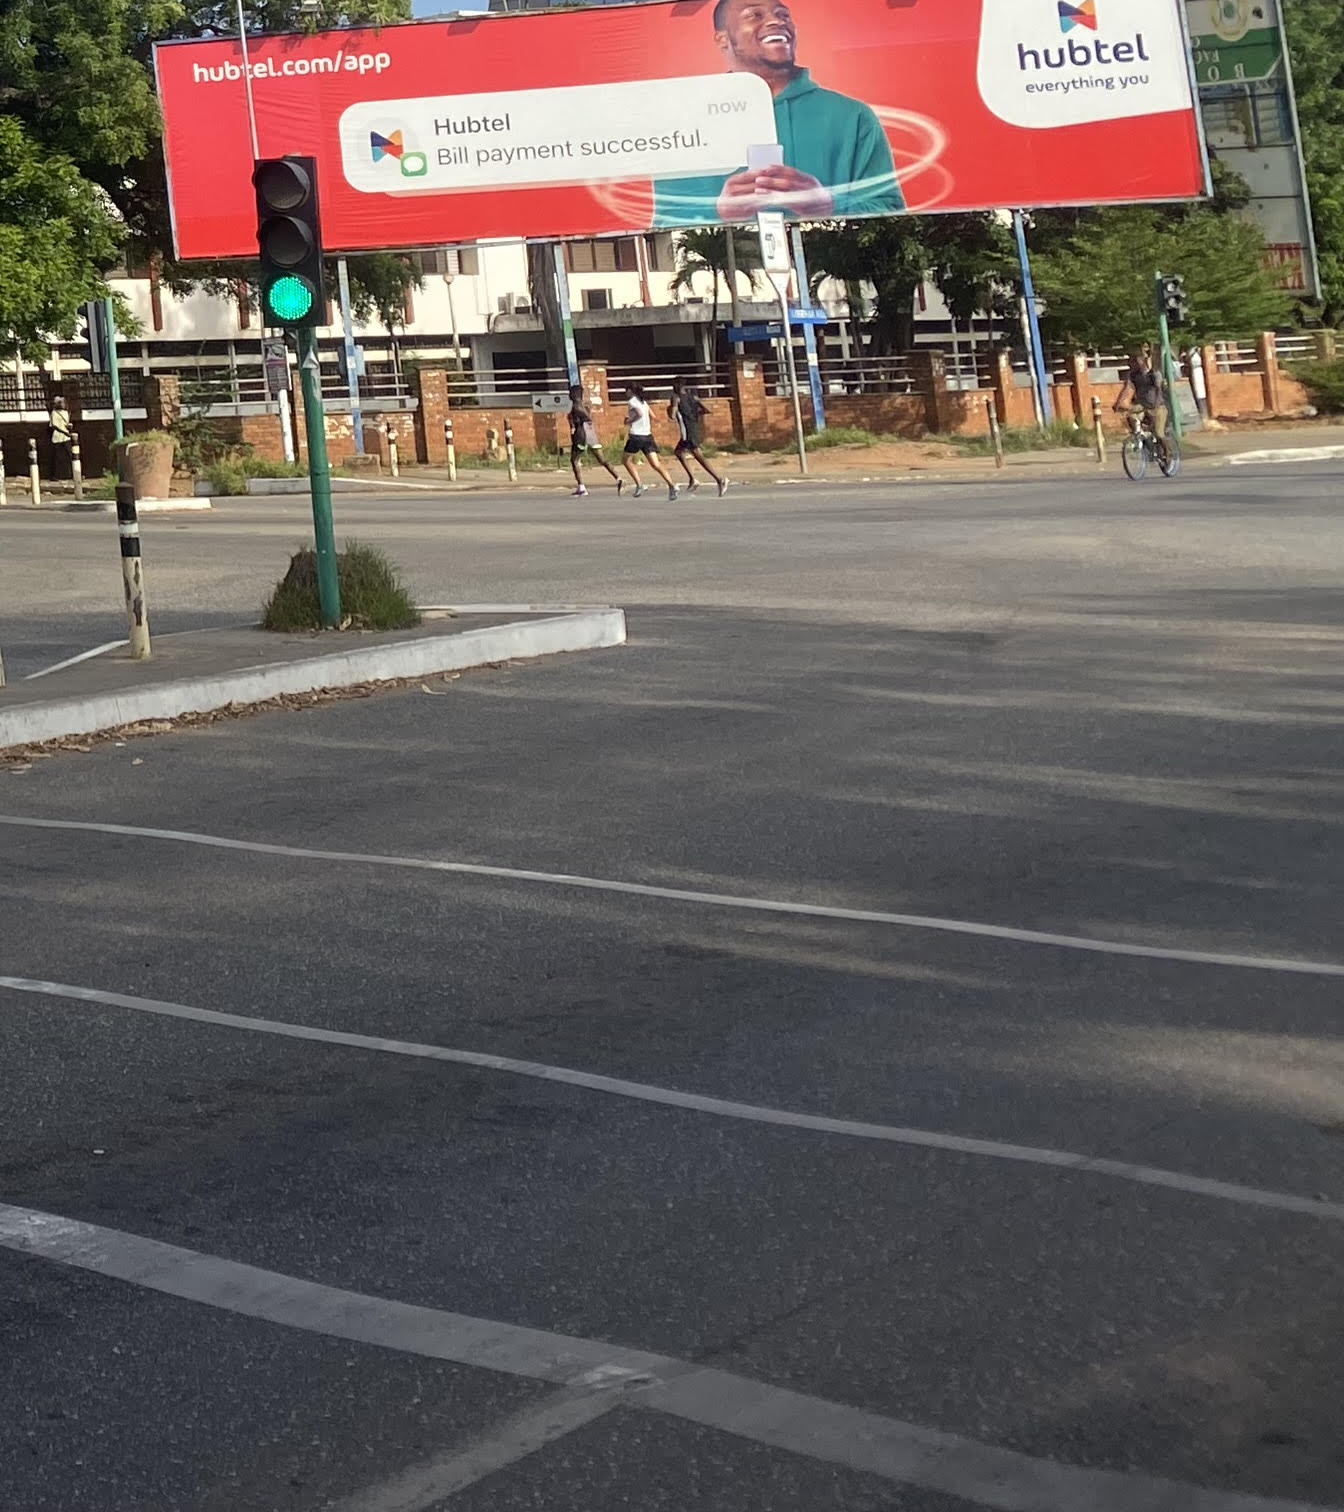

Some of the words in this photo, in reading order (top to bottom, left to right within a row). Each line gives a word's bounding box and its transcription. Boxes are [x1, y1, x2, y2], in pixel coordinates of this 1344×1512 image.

[192, 50, 391, 83] hubtel.com/app
[1017, 33, 1150, 71] hubtel
[1025, 76, 1115, 94] everything
[1118, 74, 1150, 89] you
[434, 113, 511, 136] Hubtel
[707, 99, 748, 115] now
[437, 146, 470, 166] Bill
[475, 139, 574, 167] payment
[580, 129, 709, 156] successful.
